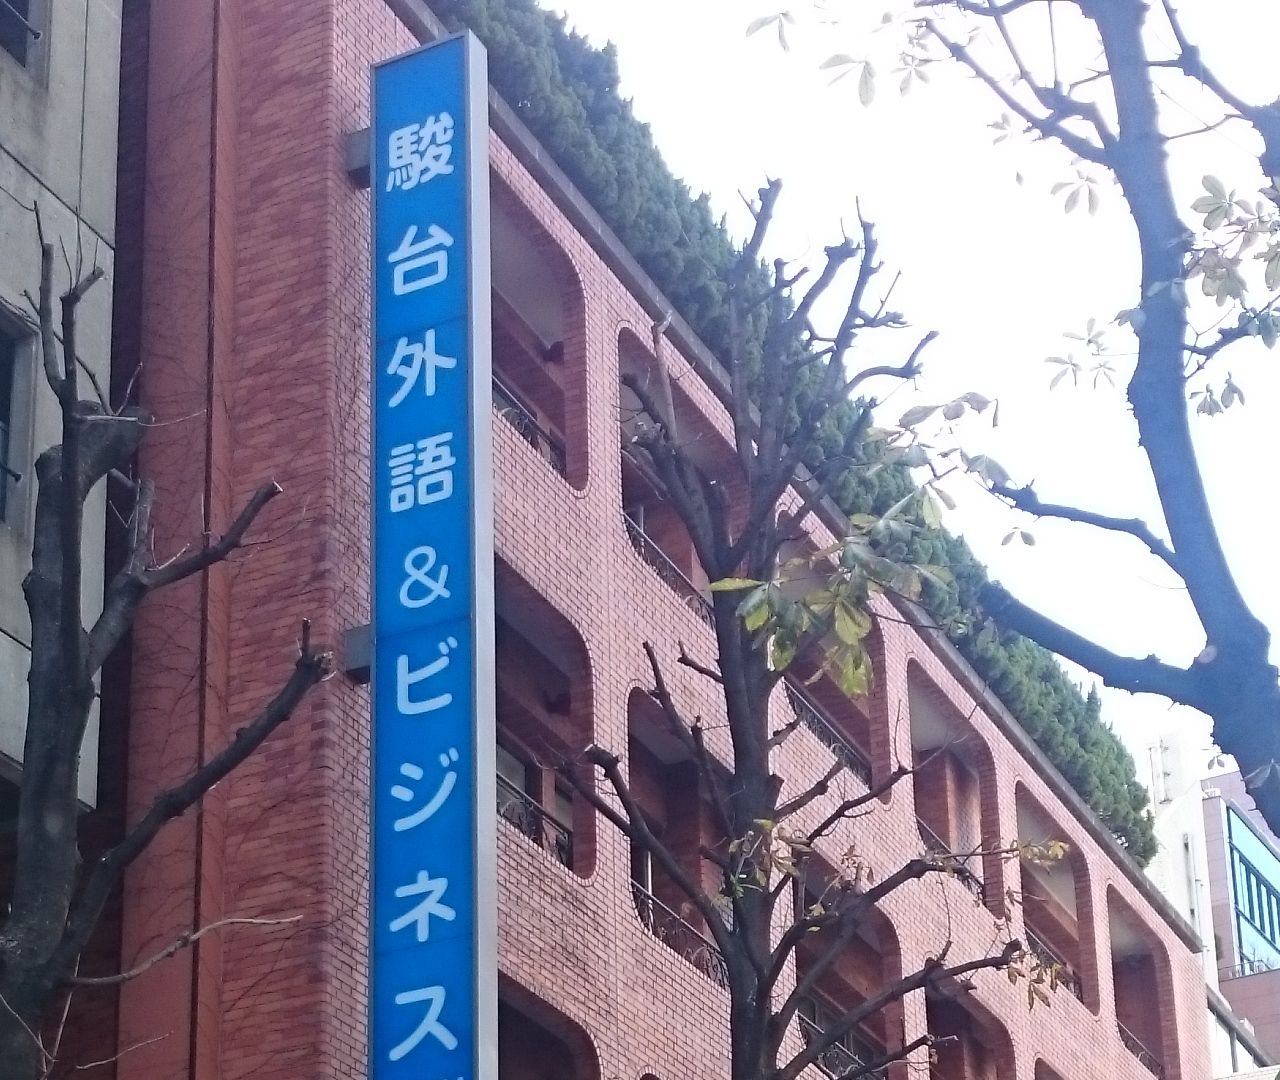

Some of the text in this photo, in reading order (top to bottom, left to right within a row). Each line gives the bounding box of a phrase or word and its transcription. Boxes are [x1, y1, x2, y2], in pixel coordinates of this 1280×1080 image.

[385, 110, 459, 1062] 駿台外語&ビジネス
